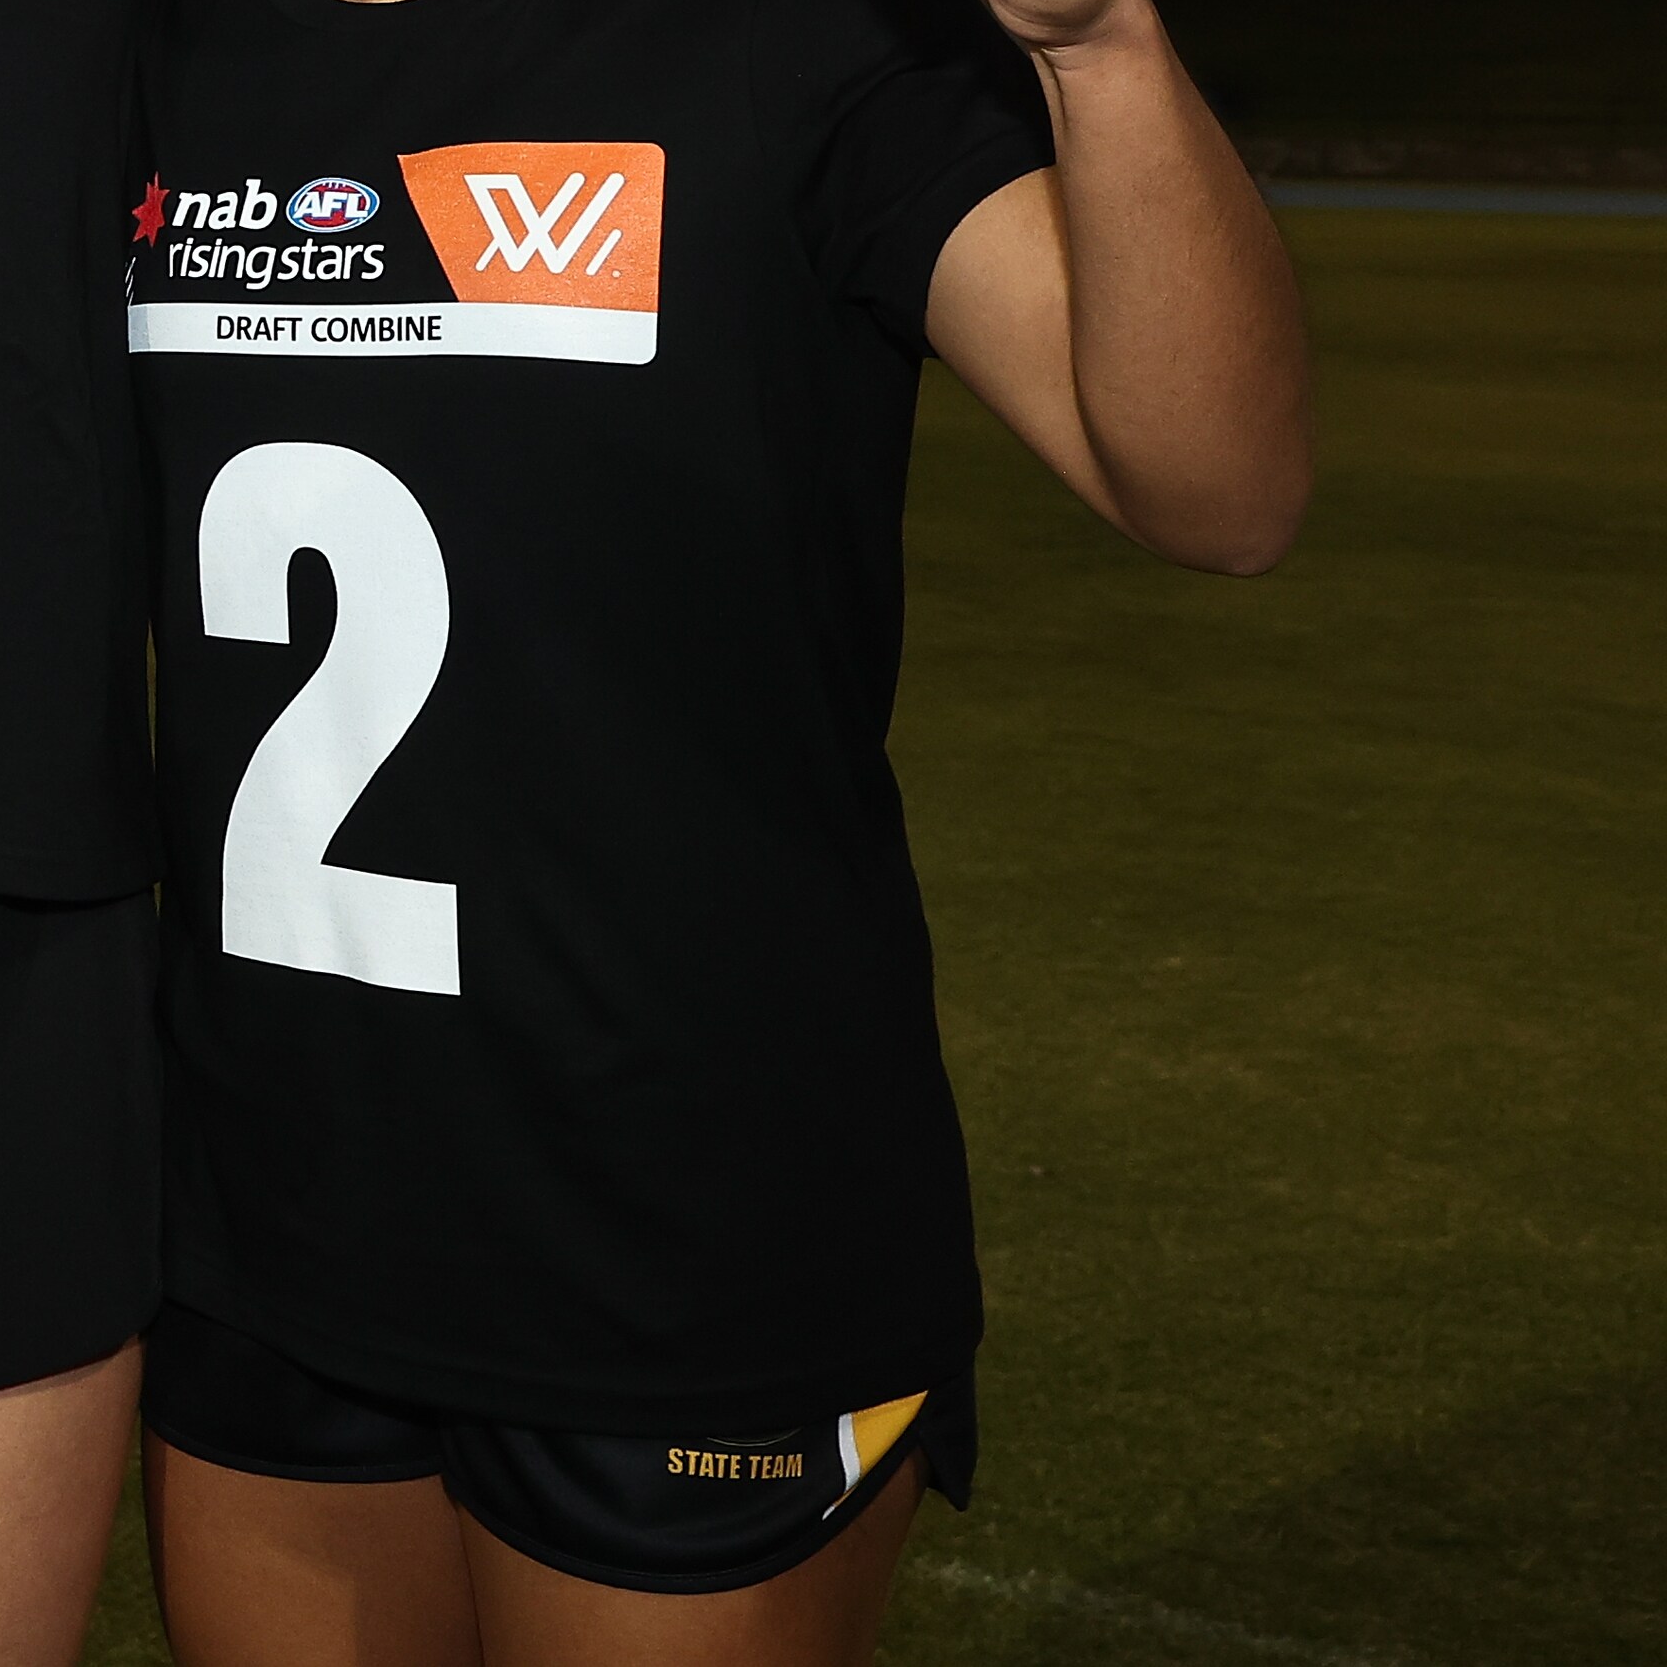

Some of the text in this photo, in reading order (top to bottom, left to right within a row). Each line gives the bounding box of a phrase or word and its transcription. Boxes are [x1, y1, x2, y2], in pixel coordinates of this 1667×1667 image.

[171, 178, 372, 230] nab AFL
[216, 315, 442, 343] DRAFT COMBINE
[198, 442, 461, 996] 2
[667, 1447, 803, 1480] STATE TEAM
